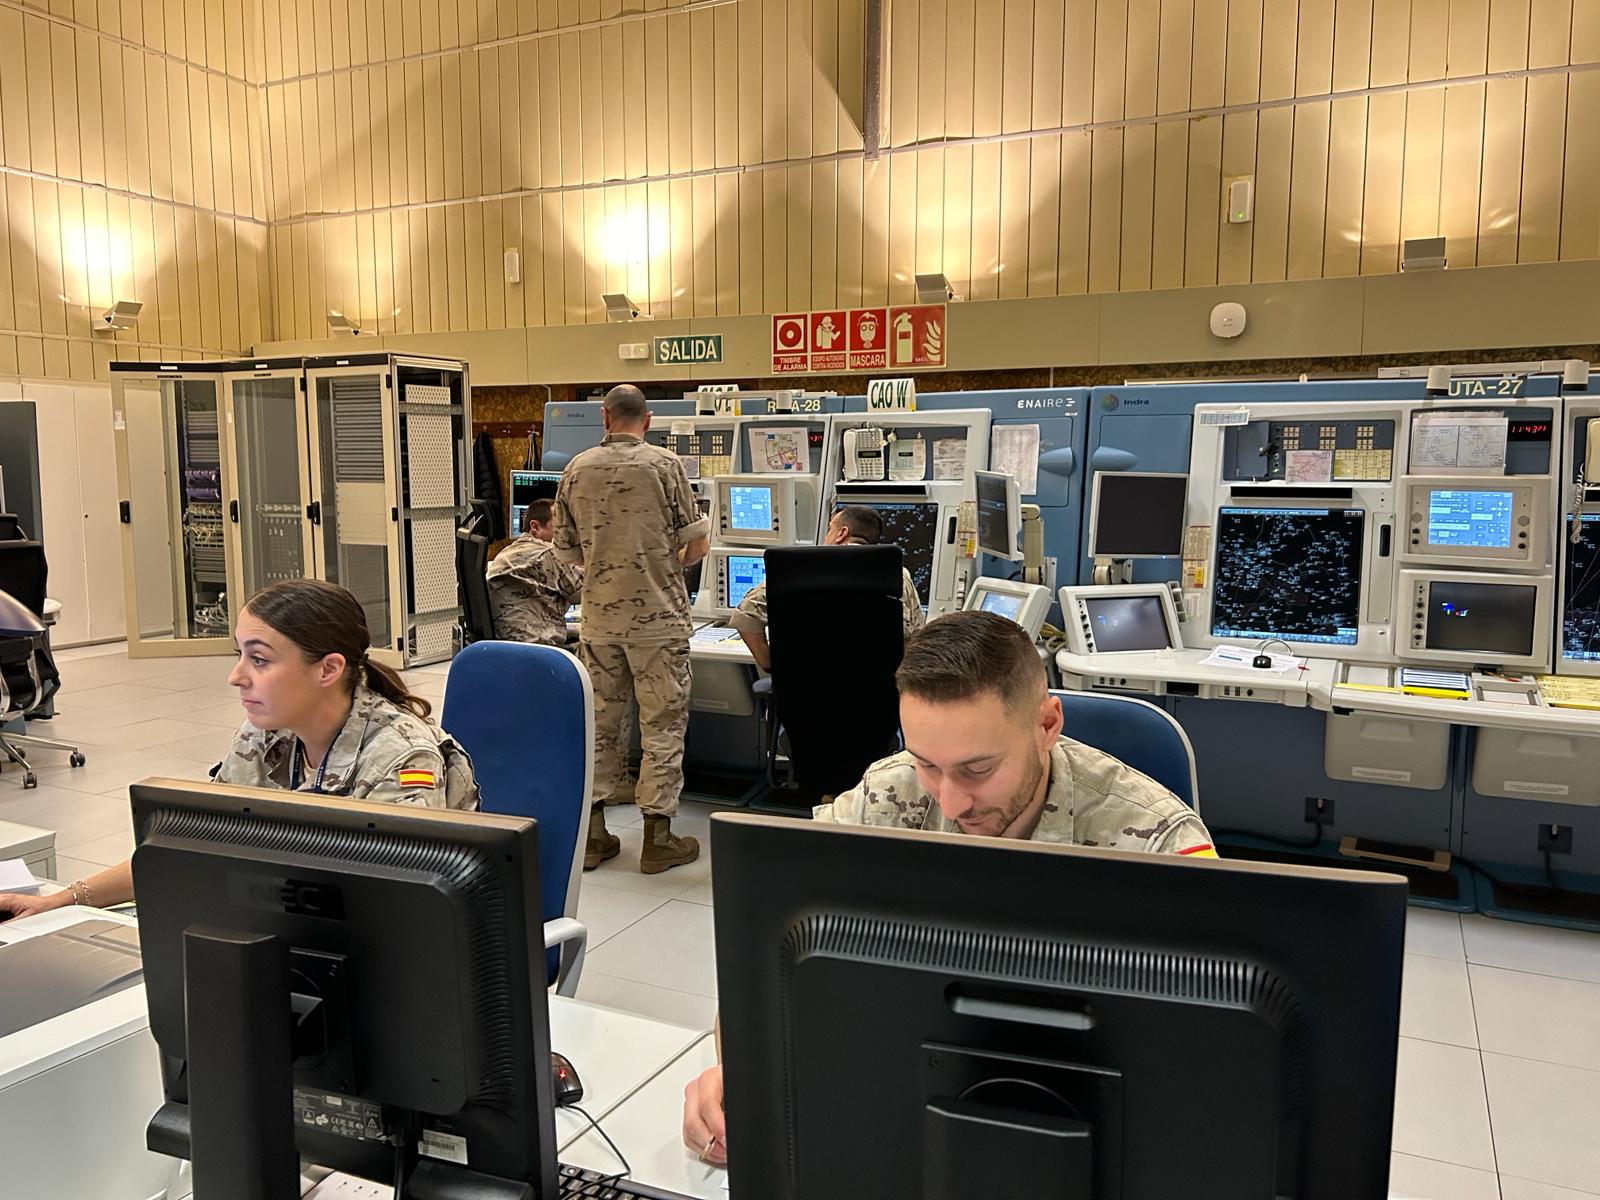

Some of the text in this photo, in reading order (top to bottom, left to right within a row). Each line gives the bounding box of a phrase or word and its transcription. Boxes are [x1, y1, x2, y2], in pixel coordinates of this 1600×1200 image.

[660, 339, 717, 361] SALIDA
[850, 354, 885, 367] MASCARA
[783, 363, 807, 371] ALARMA
[871, 380, 909, 408] CAO W
[249, 880, 321, 911] NEC
